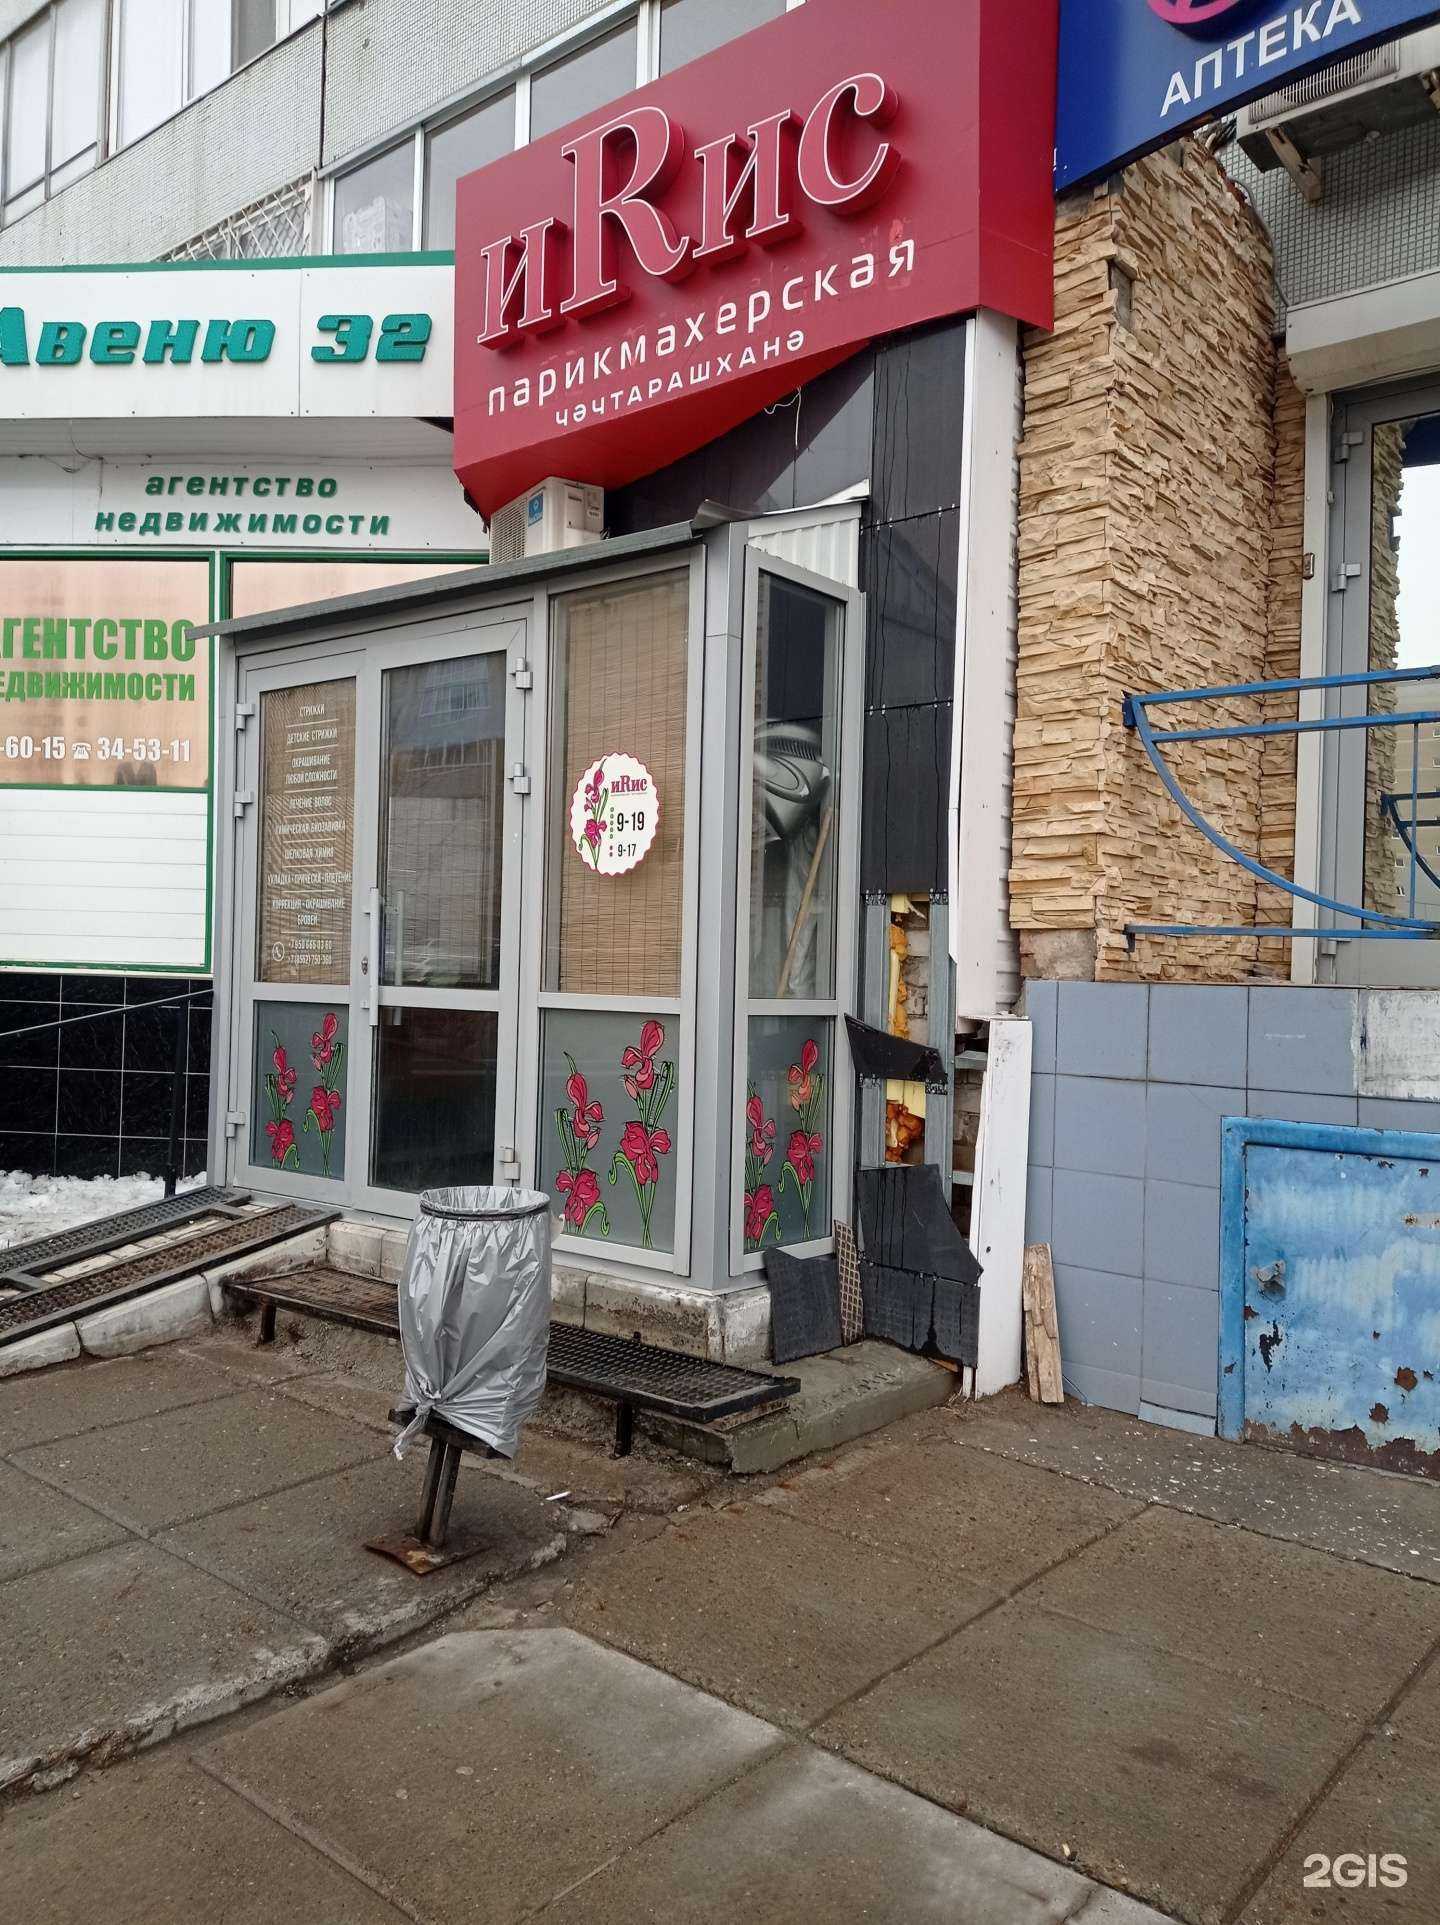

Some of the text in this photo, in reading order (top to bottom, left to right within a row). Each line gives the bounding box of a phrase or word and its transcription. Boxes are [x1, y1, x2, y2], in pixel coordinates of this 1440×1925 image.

[1160, 0, 1362, 118] АПТЕКА
[311, 313, 433, 364] 32
[487, 239, 916, 416] парикмахерская
[145, 474, 339, 498] агентство
[94, 510, 391, 537] недвижимости
[0, 617, 196, 661] ГЕНТСТВО
[300, 704, 325, 717] СТРИЖКИ
[286, 728, 337, 746] ДЕТСКИЕ СТРИЖКИ
[97, 737, 191, 761] 34-53-11
[292, 754, 331, 768] ОКРАШИВАНИЕ
[304, 769, 338, 783] СЛОЖНОСТИ
[617, 811, 645, 832] 9-19
[618, 843, 637, 857] 9-17
[305, 898, 344, 909] ОКРАШИВАНИЕ
